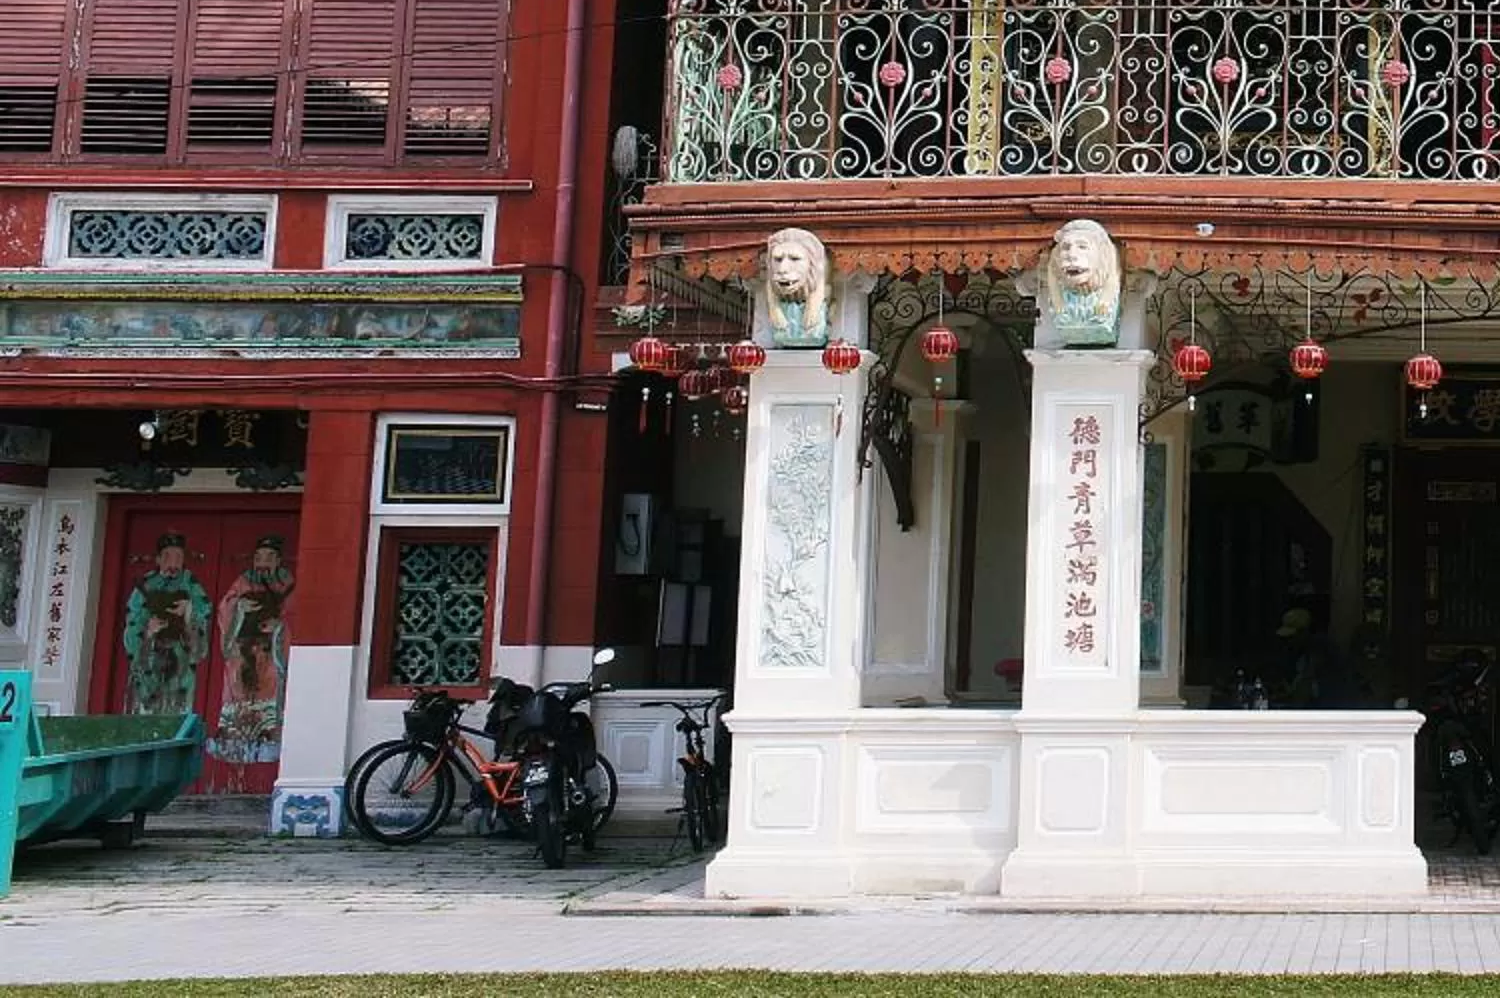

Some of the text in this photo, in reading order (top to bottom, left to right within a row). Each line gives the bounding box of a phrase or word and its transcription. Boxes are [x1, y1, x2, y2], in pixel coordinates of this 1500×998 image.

[1065, 416, 1100, 653] 德門青草滿池塘
